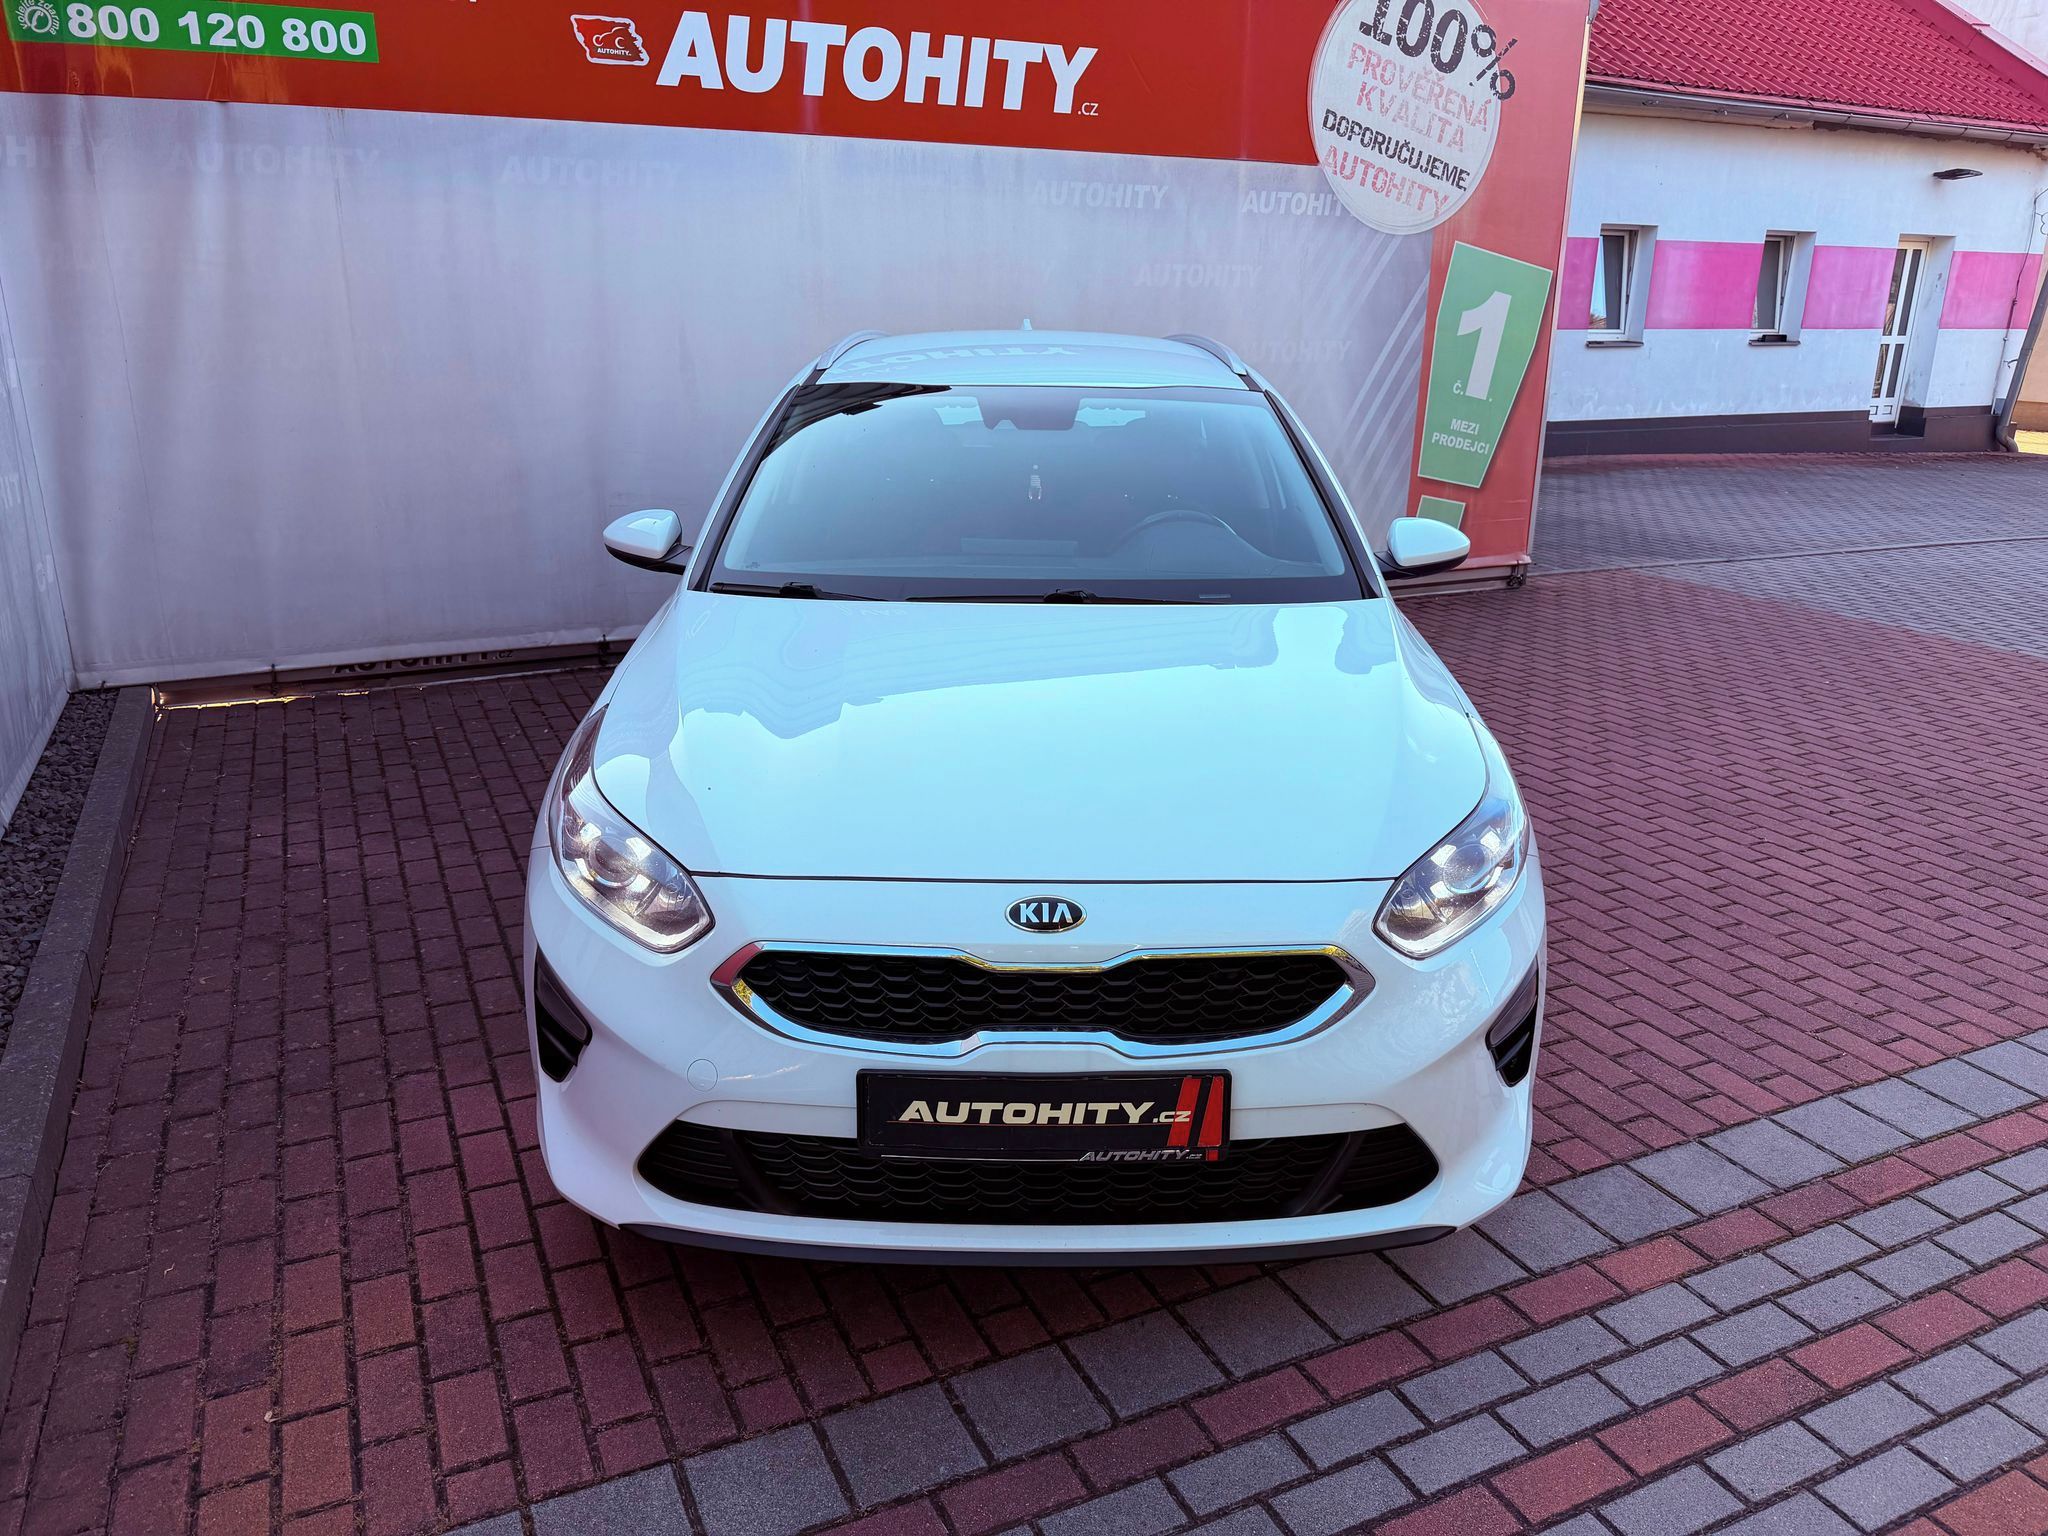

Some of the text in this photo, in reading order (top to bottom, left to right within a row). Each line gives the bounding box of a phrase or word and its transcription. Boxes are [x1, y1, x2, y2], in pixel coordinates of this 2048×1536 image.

[66, 2, 367, 56] 800 120 800
[1359, 0, 1518, 101] 100%
[1346, 42, 1493, 133] PROVĚŘENÁ
[1355, 81, 1465, 153] KVALITA
[497, 154, 689, 189] AUTOHITY
[1321, 108, 1471, 192] DOPORUČUJEME
[1032, 180, 1170, 210] AUTOHITY
[1241, 189, 1353, 217] AUTOHIT
[1323, 145, 1451, 219] AUTOHITY
[1431, 432, 1490, 455] PRODEJCI
[1450, 418, 1480, 436] MEZI
[1019, 902, 1073, 923] KIA
